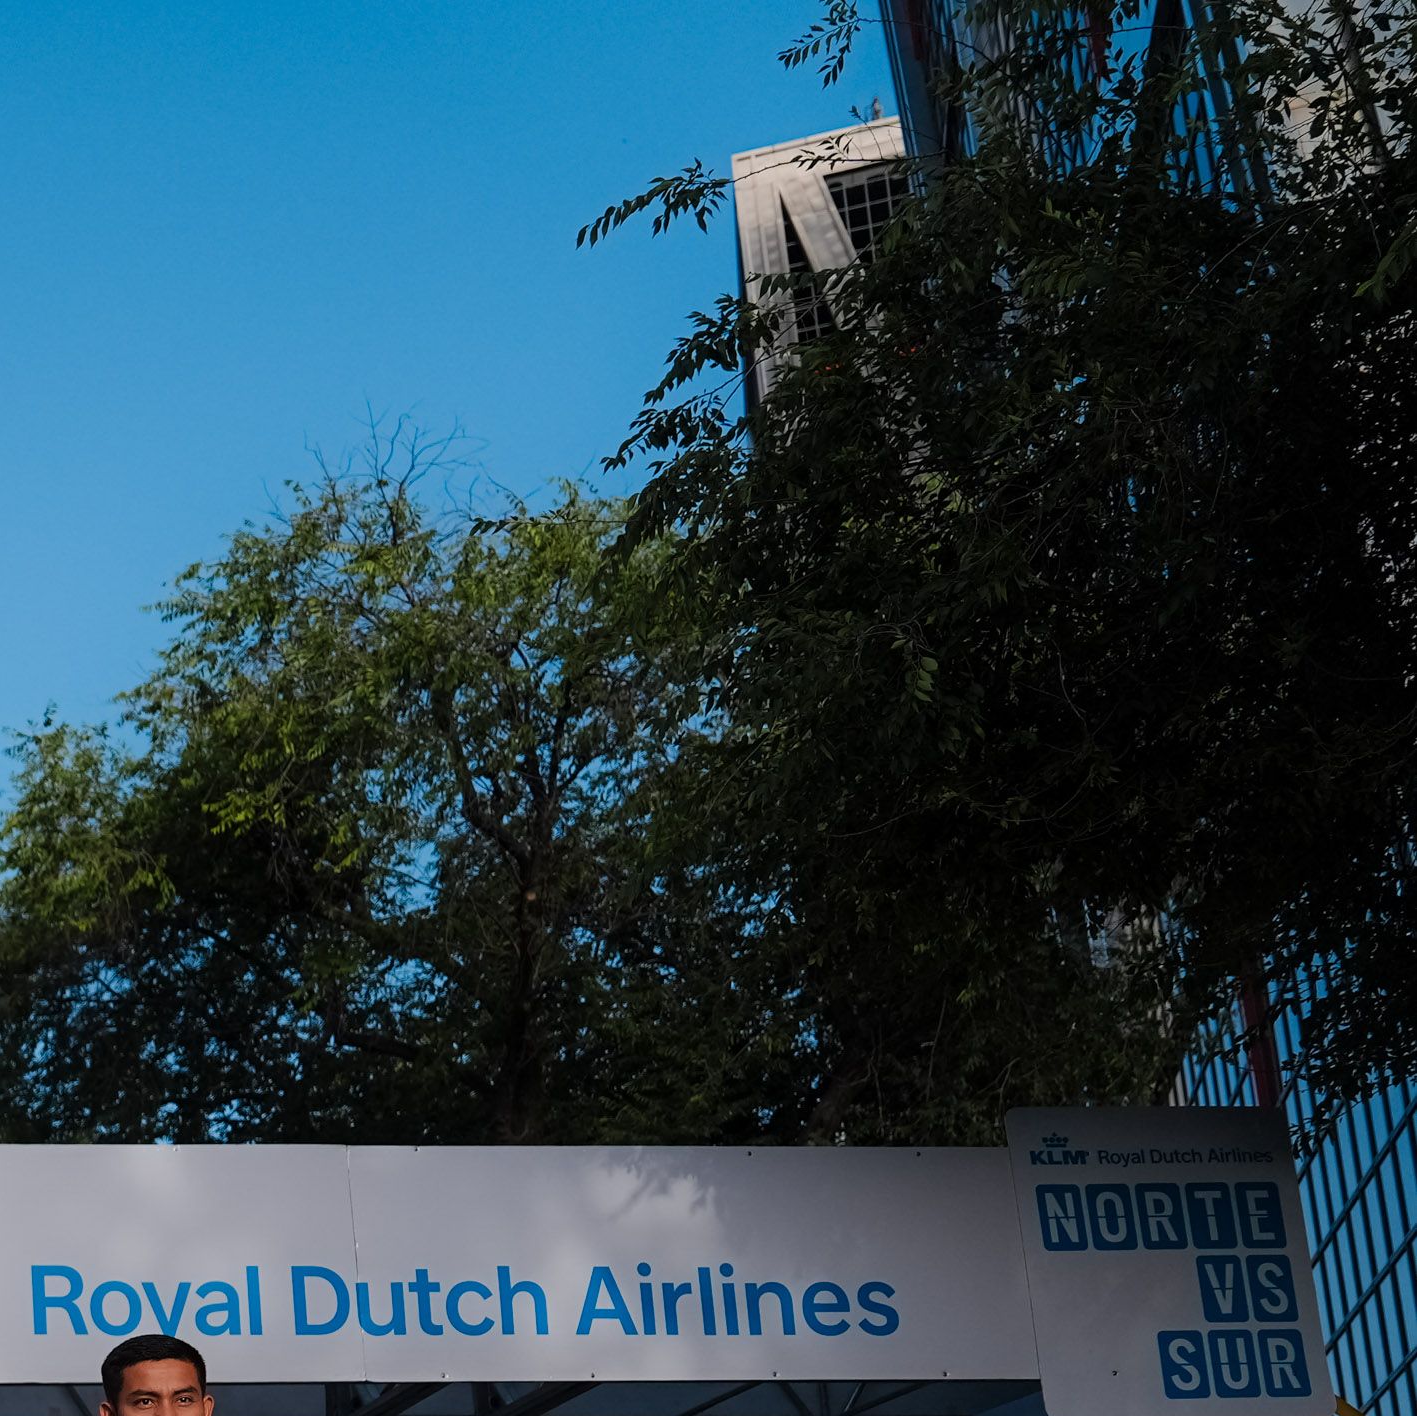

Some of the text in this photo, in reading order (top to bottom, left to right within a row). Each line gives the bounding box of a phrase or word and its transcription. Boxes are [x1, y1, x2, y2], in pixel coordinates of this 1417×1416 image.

[1030, 1148, 1274, 1168] KLM Royal Dutch Airlines
[1042, 1186, 1280, 1249] NORTE
[31, 1265, 263, 1338] Royal
[290, 1265, 549, 1337] Dutch
[576, 1261, 900, 1337] Airlines
[1200, 1257, 1296, 1321] VS
[1163, 1332, 1307, 1396] SUR
